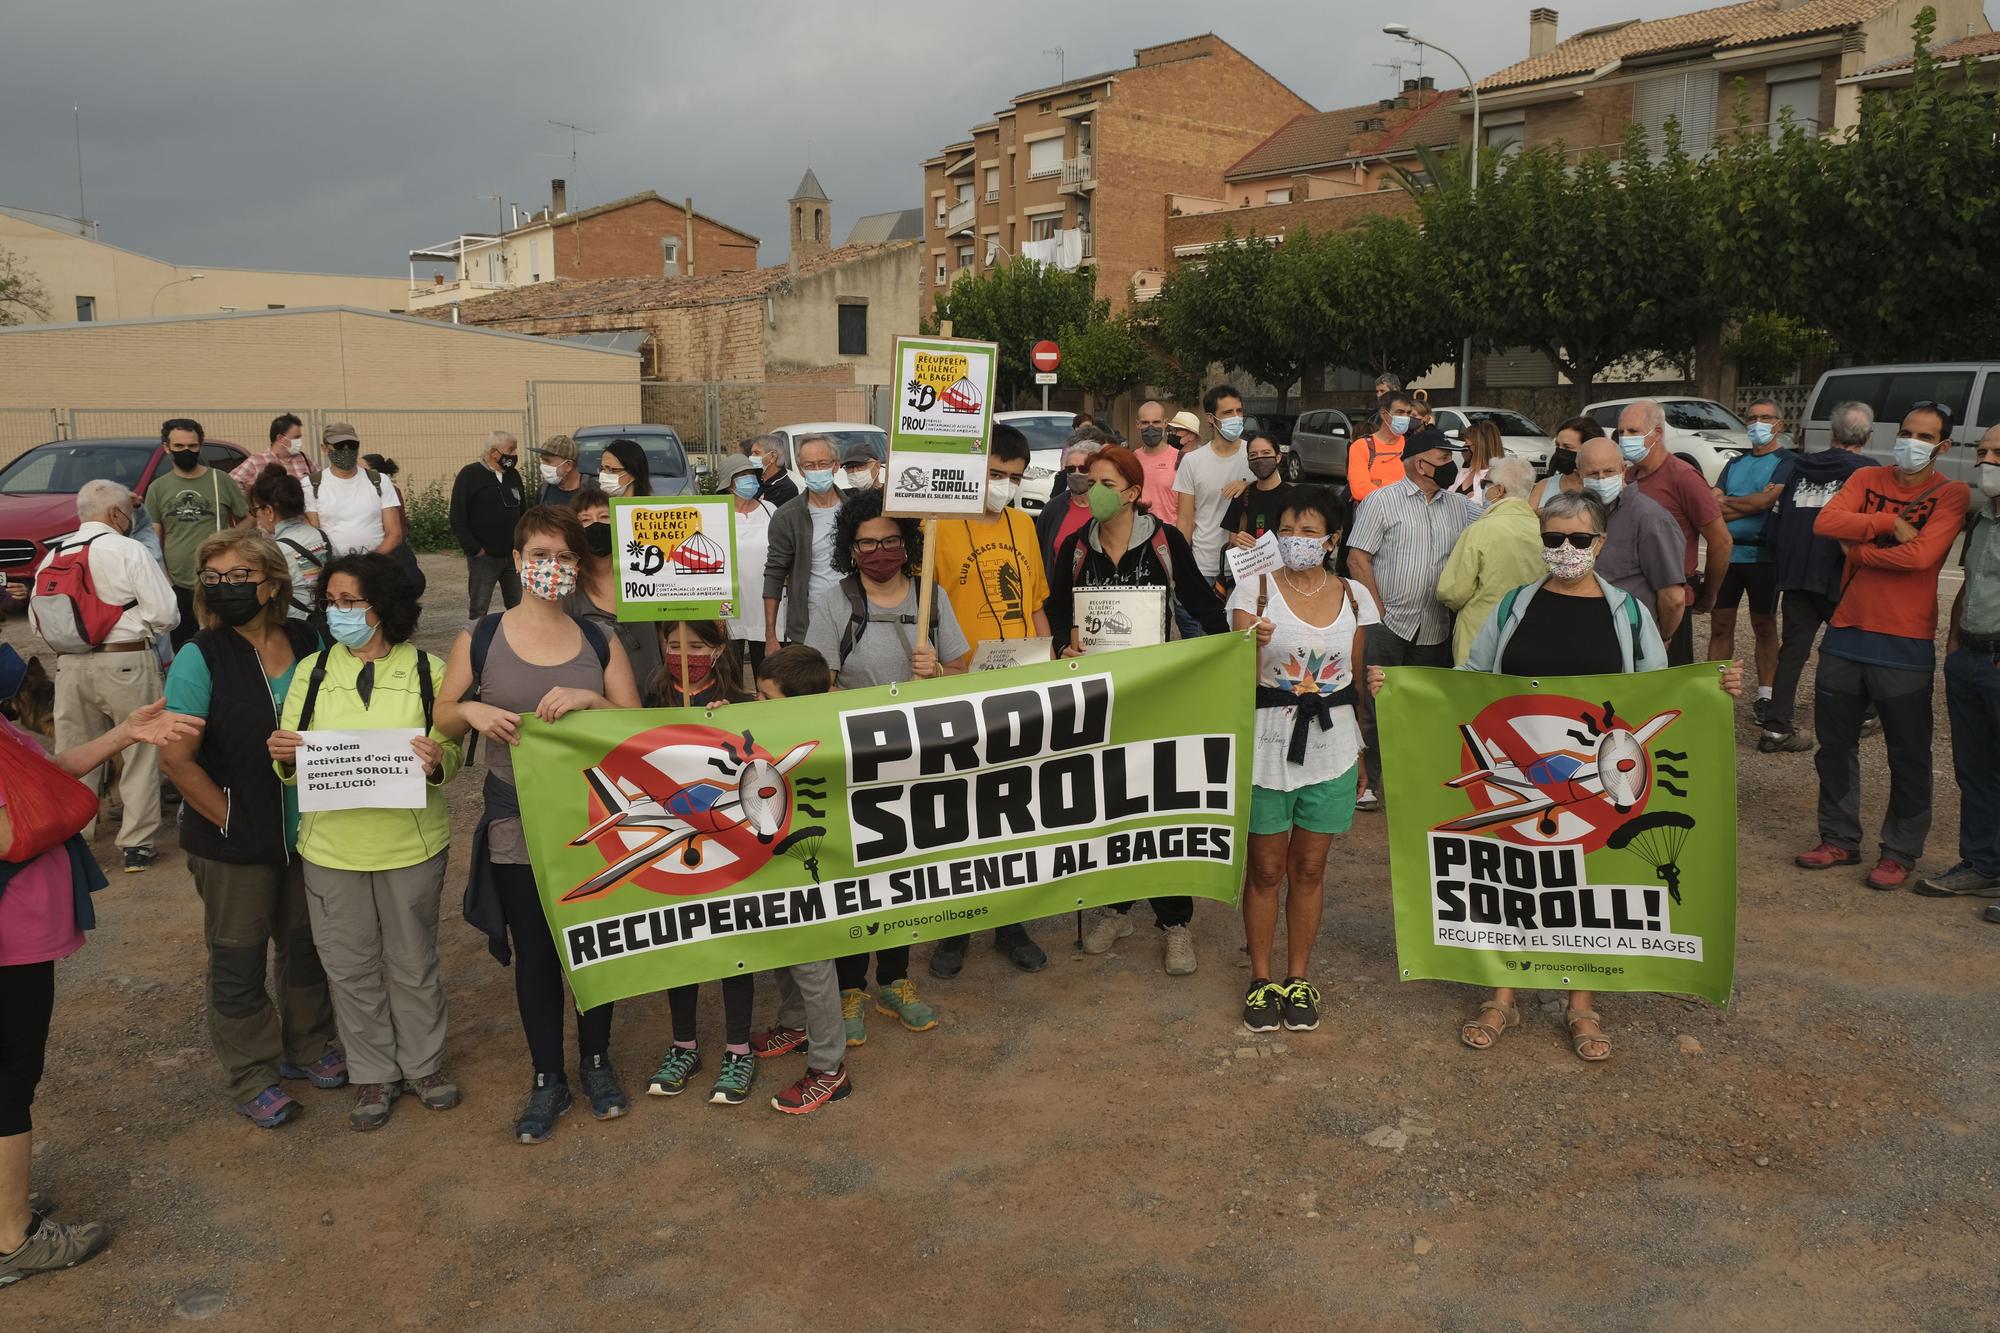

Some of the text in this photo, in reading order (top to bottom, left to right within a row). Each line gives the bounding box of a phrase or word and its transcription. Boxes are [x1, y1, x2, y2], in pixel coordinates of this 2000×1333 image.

[918, 356, 966, 365] RECUPEREM
[930, 374, 954, 382] BAGES
[901, 416, 926, 430] PROU
[932, 469, 964, 480] PROU
[931, 481, 979, 492] SOROLL!
[636, 510, 698, 520] RECUPEREM
[634, 522, 645, 530] EL
[638, 530, 685, 540] AL BAGES
[960, 562, 970, 585] CLUB
[967, 542, 996, 562] ESCACS
[625, 582, 656, 598] PROU
[846, 678, 1108, 783] PROU
[307, 743, 360, 752] No volem
[307, 754, 414, 766] activitats d'oci que
[308, 770, 353, 780] generen
[308, 778, 376, 791] POL.LUCIÓ!
[851, 737, 1230, 862] SOROLL!
[1433, 836, 1578, 890] PROU
[567, 826, 1232, 966] RECUPEREM EL SILENCI AL BAGES
[1436, 880, 1662, 932] SOROLL!
[884, 906, 988, 934] prousorollbages
[1439, 928, 1696, 954] RECUPEREM EL SILENCI AL BAGES
[1534, 961, 1624, 976] prousorollbages
